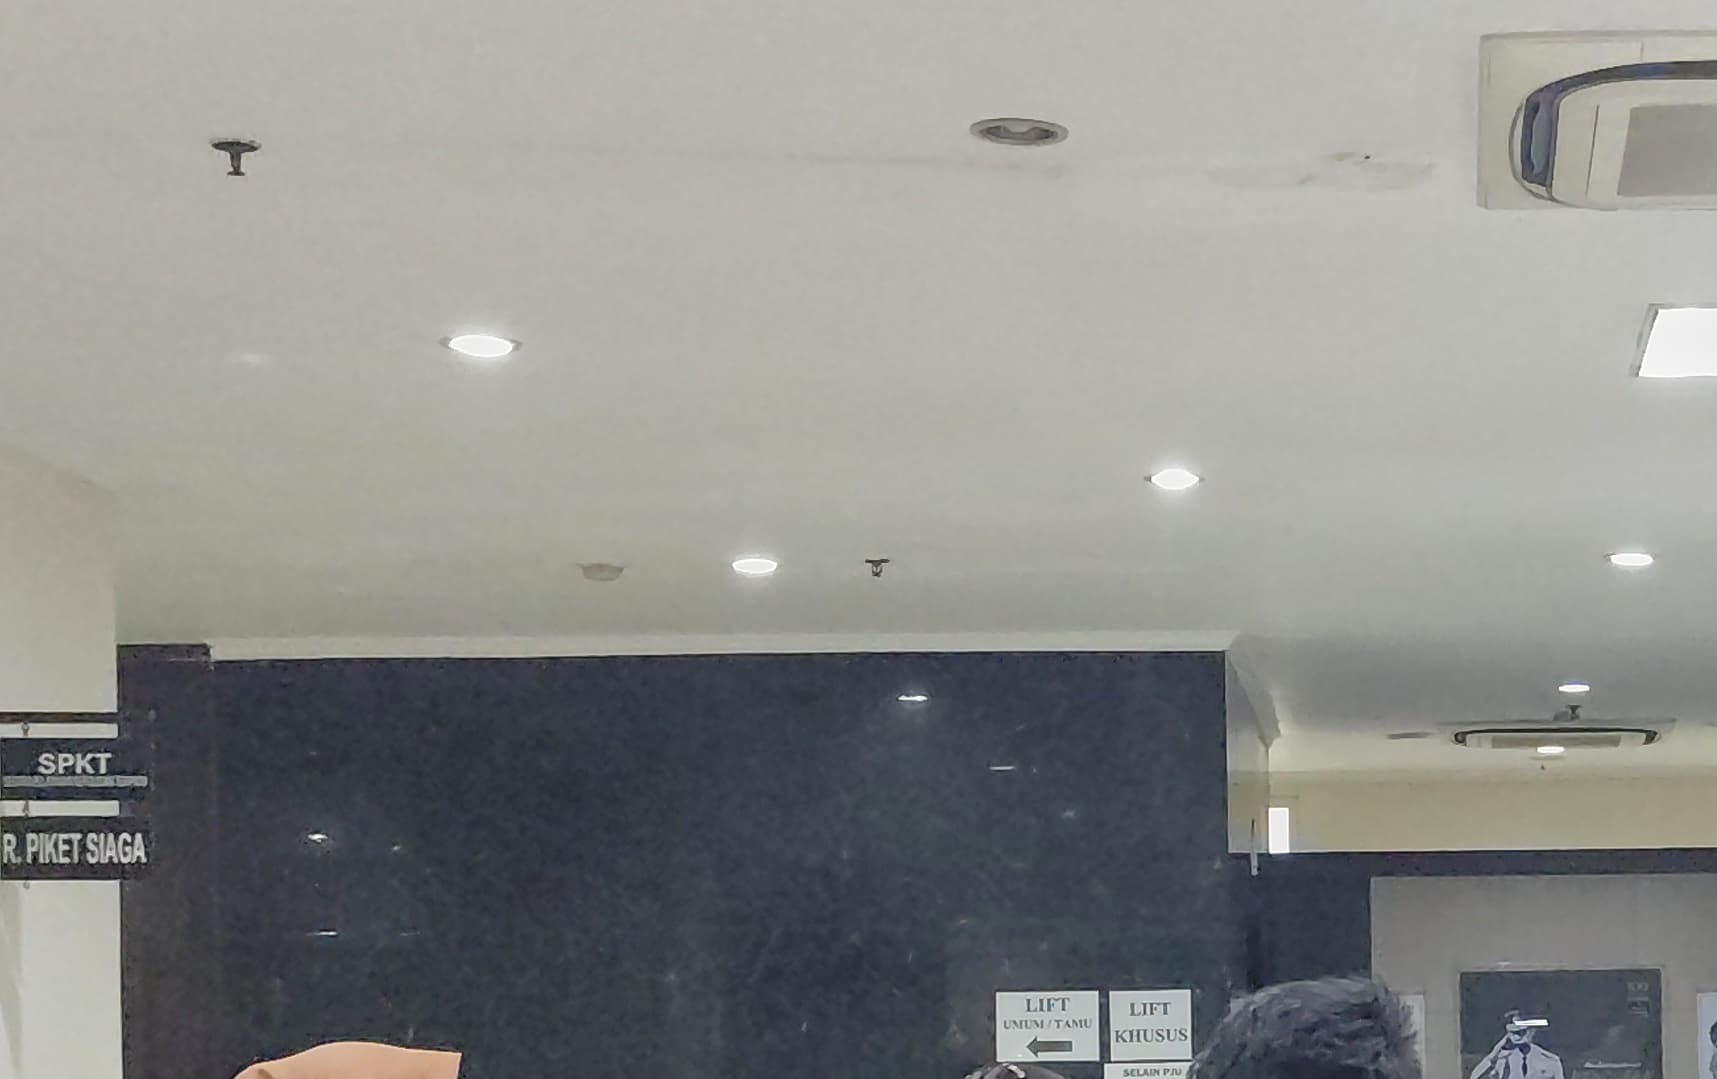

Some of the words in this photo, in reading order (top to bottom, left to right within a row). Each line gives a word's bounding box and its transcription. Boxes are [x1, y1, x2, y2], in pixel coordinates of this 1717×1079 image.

[37, 752, 113, 775] SPKT
[2, 832, 22, 864] R.
[25, 832, 83, 864] PIKET
[86, 832, 148, 865] SIAGA
[1025, 997, 1070, 1013] LIFT
[1129, 1001, 1172, 1017] LIFT
[1114, 1028, 1188, 1044] KHUSUS
[1123, 1068, 1160, 1077] SELAIN
